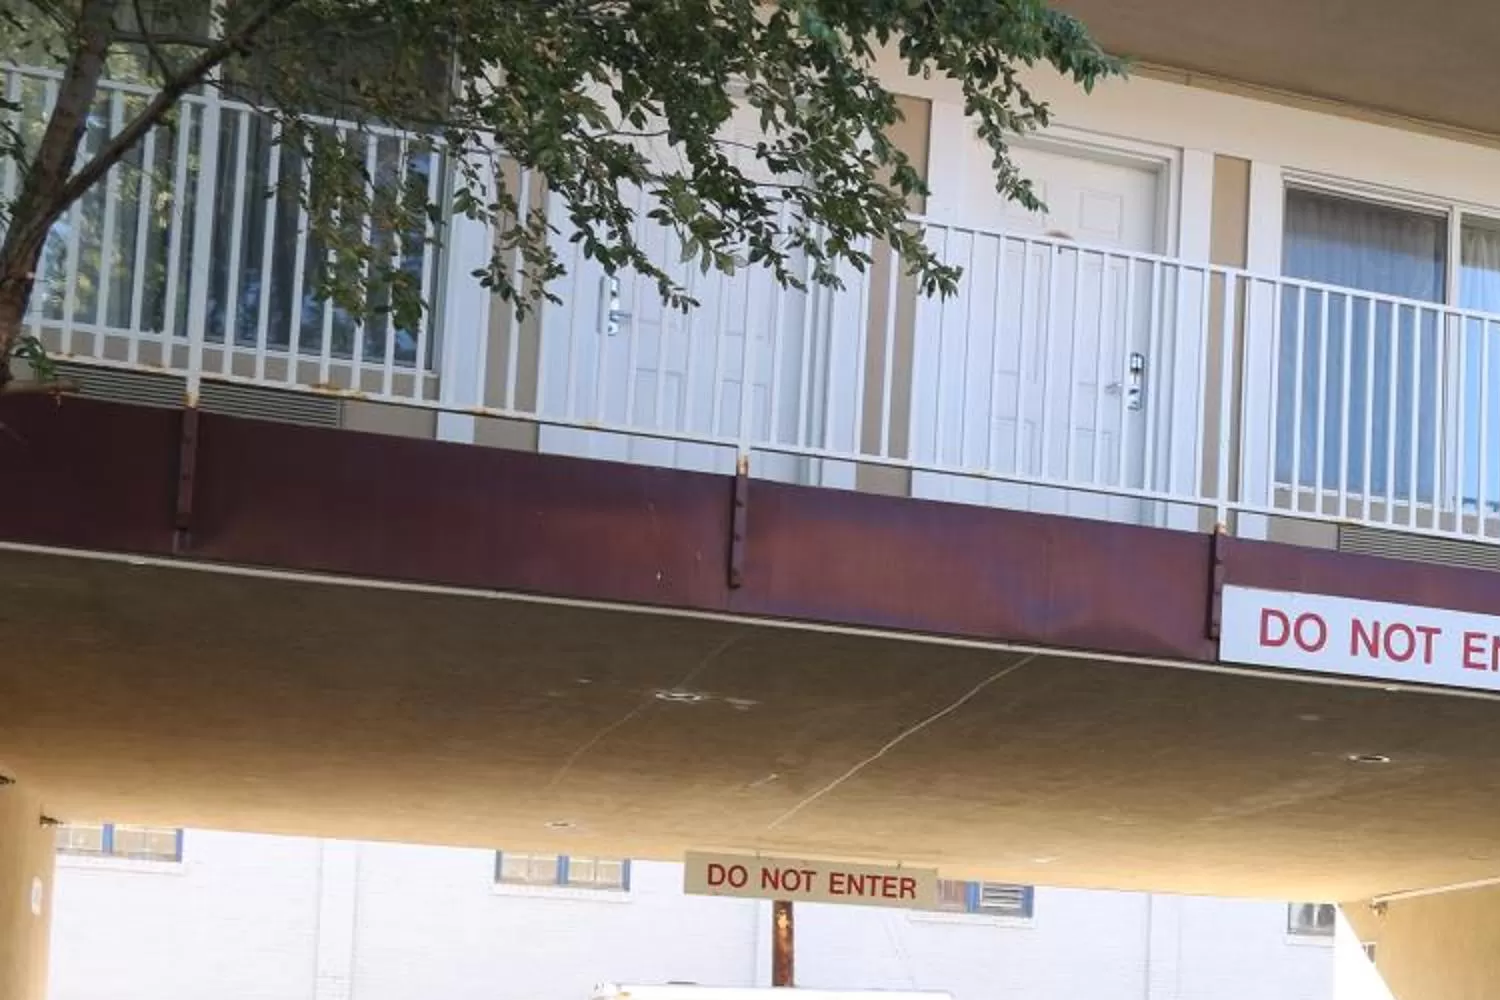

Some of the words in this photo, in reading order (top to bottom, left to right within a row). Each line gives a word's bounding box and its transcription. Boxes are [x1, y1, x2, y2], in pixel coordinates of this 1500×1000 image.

[1259, 608, 1327, 653] DO
[1350, 619, 1441, 664] NOT
[707, 863, 748, 888] DO
[761, 868, 817, 892] NOT
[829, 872, 917, 899] ENTER
